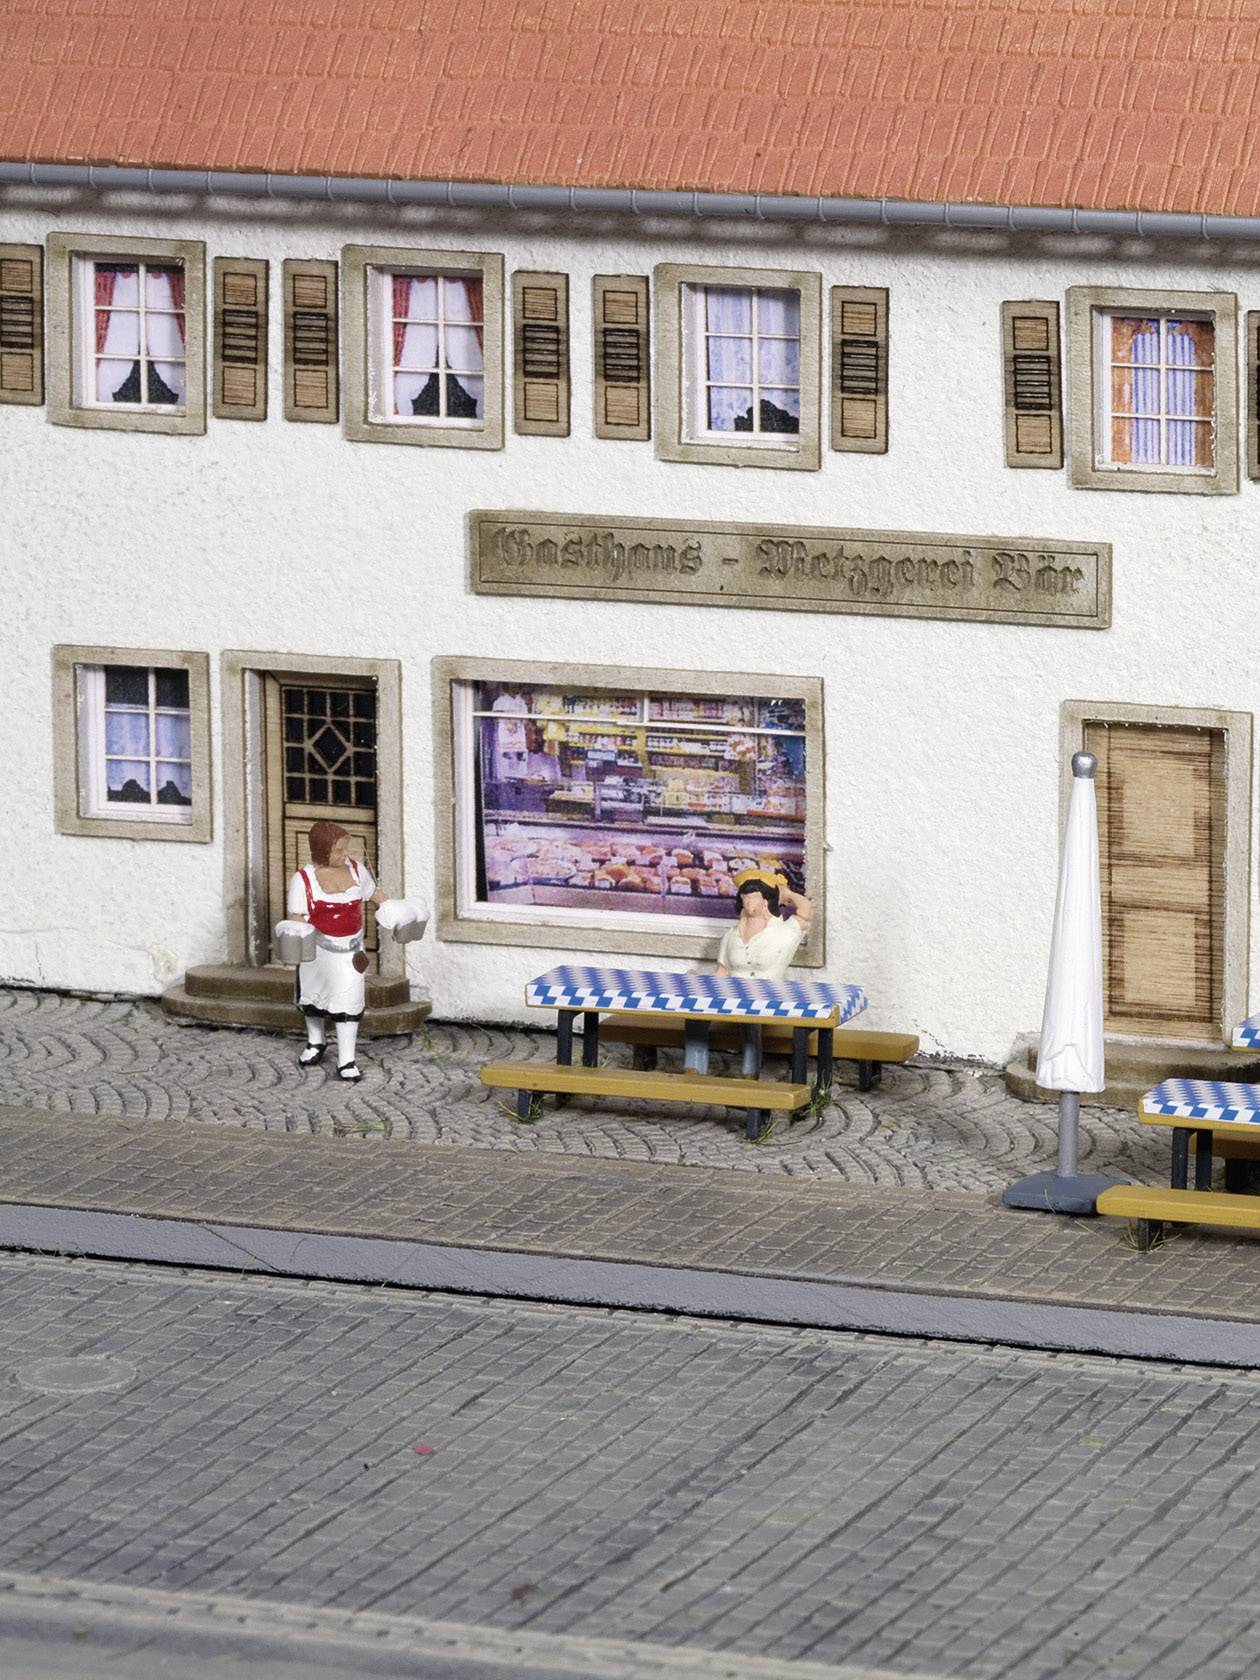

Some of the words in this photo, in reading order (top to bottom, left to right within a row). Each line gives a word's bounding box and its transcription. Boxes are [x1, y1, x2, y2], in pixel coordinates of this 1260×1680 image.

[492, 527, 703, 581] Gasthaus
[755, 538, 976, 599] Metzgerei
[992, 551, 1085, 596] Bär
